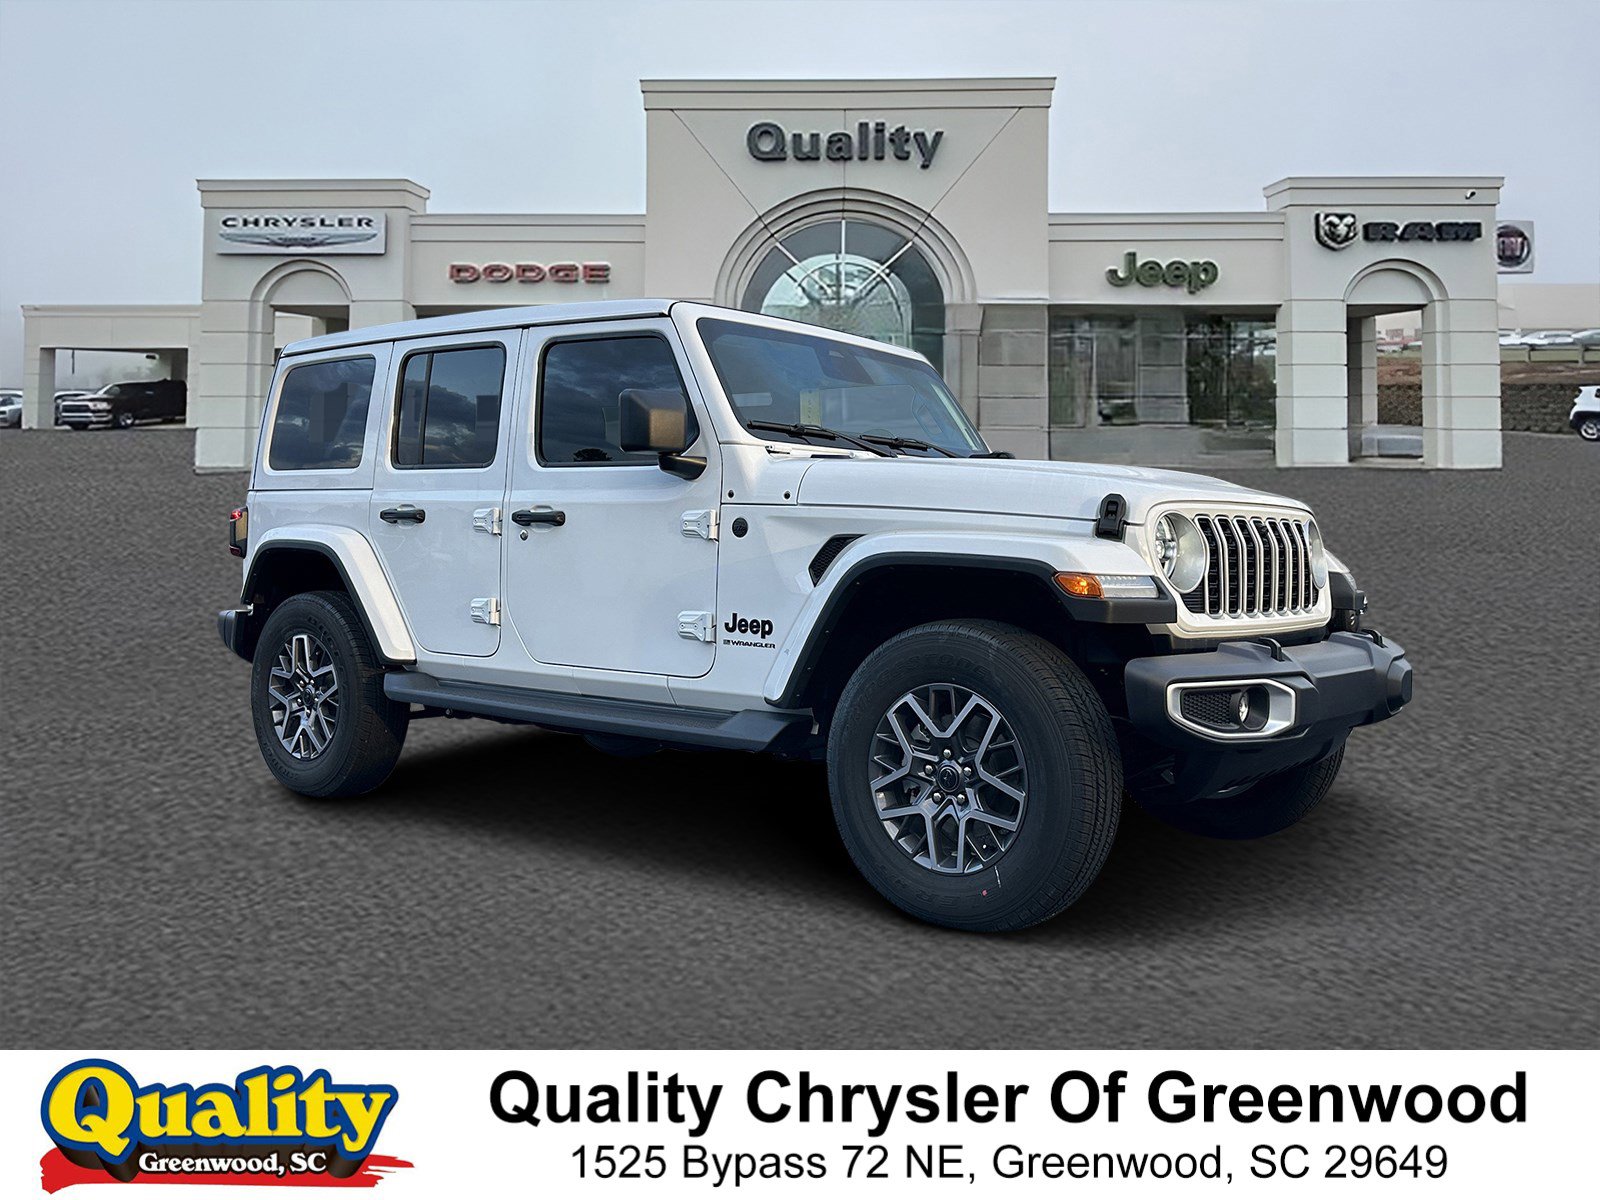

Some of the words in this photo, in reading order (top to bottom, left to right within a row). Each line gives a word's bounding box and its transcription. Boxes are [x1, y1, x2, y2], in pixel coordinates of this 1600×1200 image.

[747, 121, 944, 169] Quality
[221, 217, 375, 228] CHRYSLER
[1362, 221, 1482, 241] RAM
[449, 262, 612, 284] DODGE
[1105, 251, 1219, 294] Jeep
[724, 612, 773, 639] Jeep
[731, 639, 776, 649] WRANGLER
